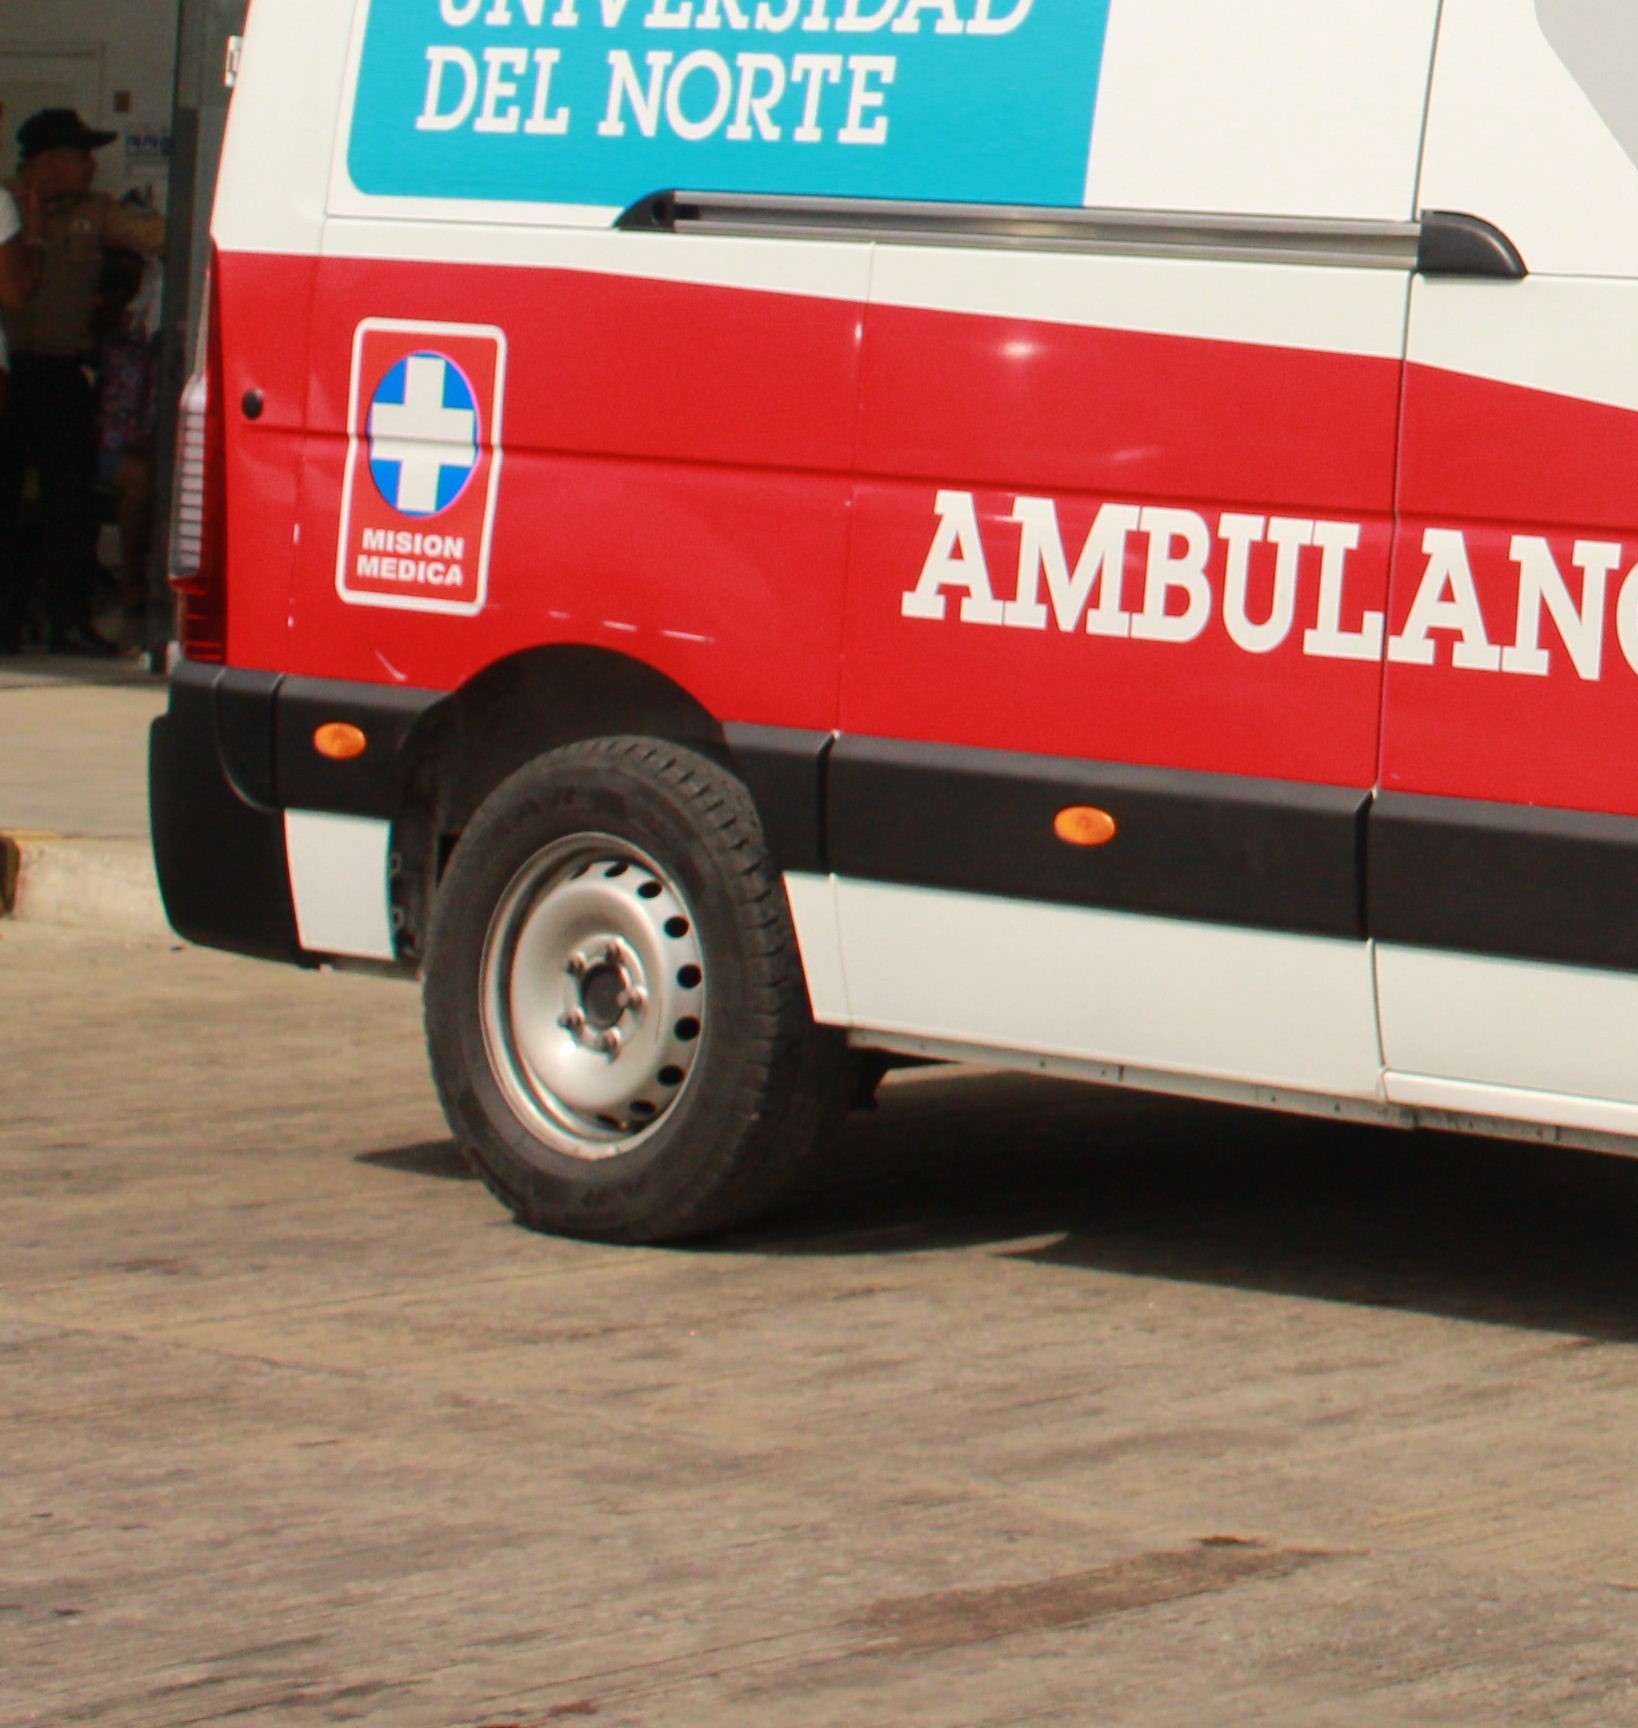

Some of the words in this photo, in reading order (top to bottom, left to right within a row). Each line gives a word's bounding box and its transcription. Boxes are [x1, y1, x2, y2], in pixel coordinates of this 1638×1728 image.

[415, 46, 570, 134] DEL
[597, 49, 897, 145] NORTE
[361, 527, 464, 560] MISION
[356, 554, 463, 587] MEDICA
